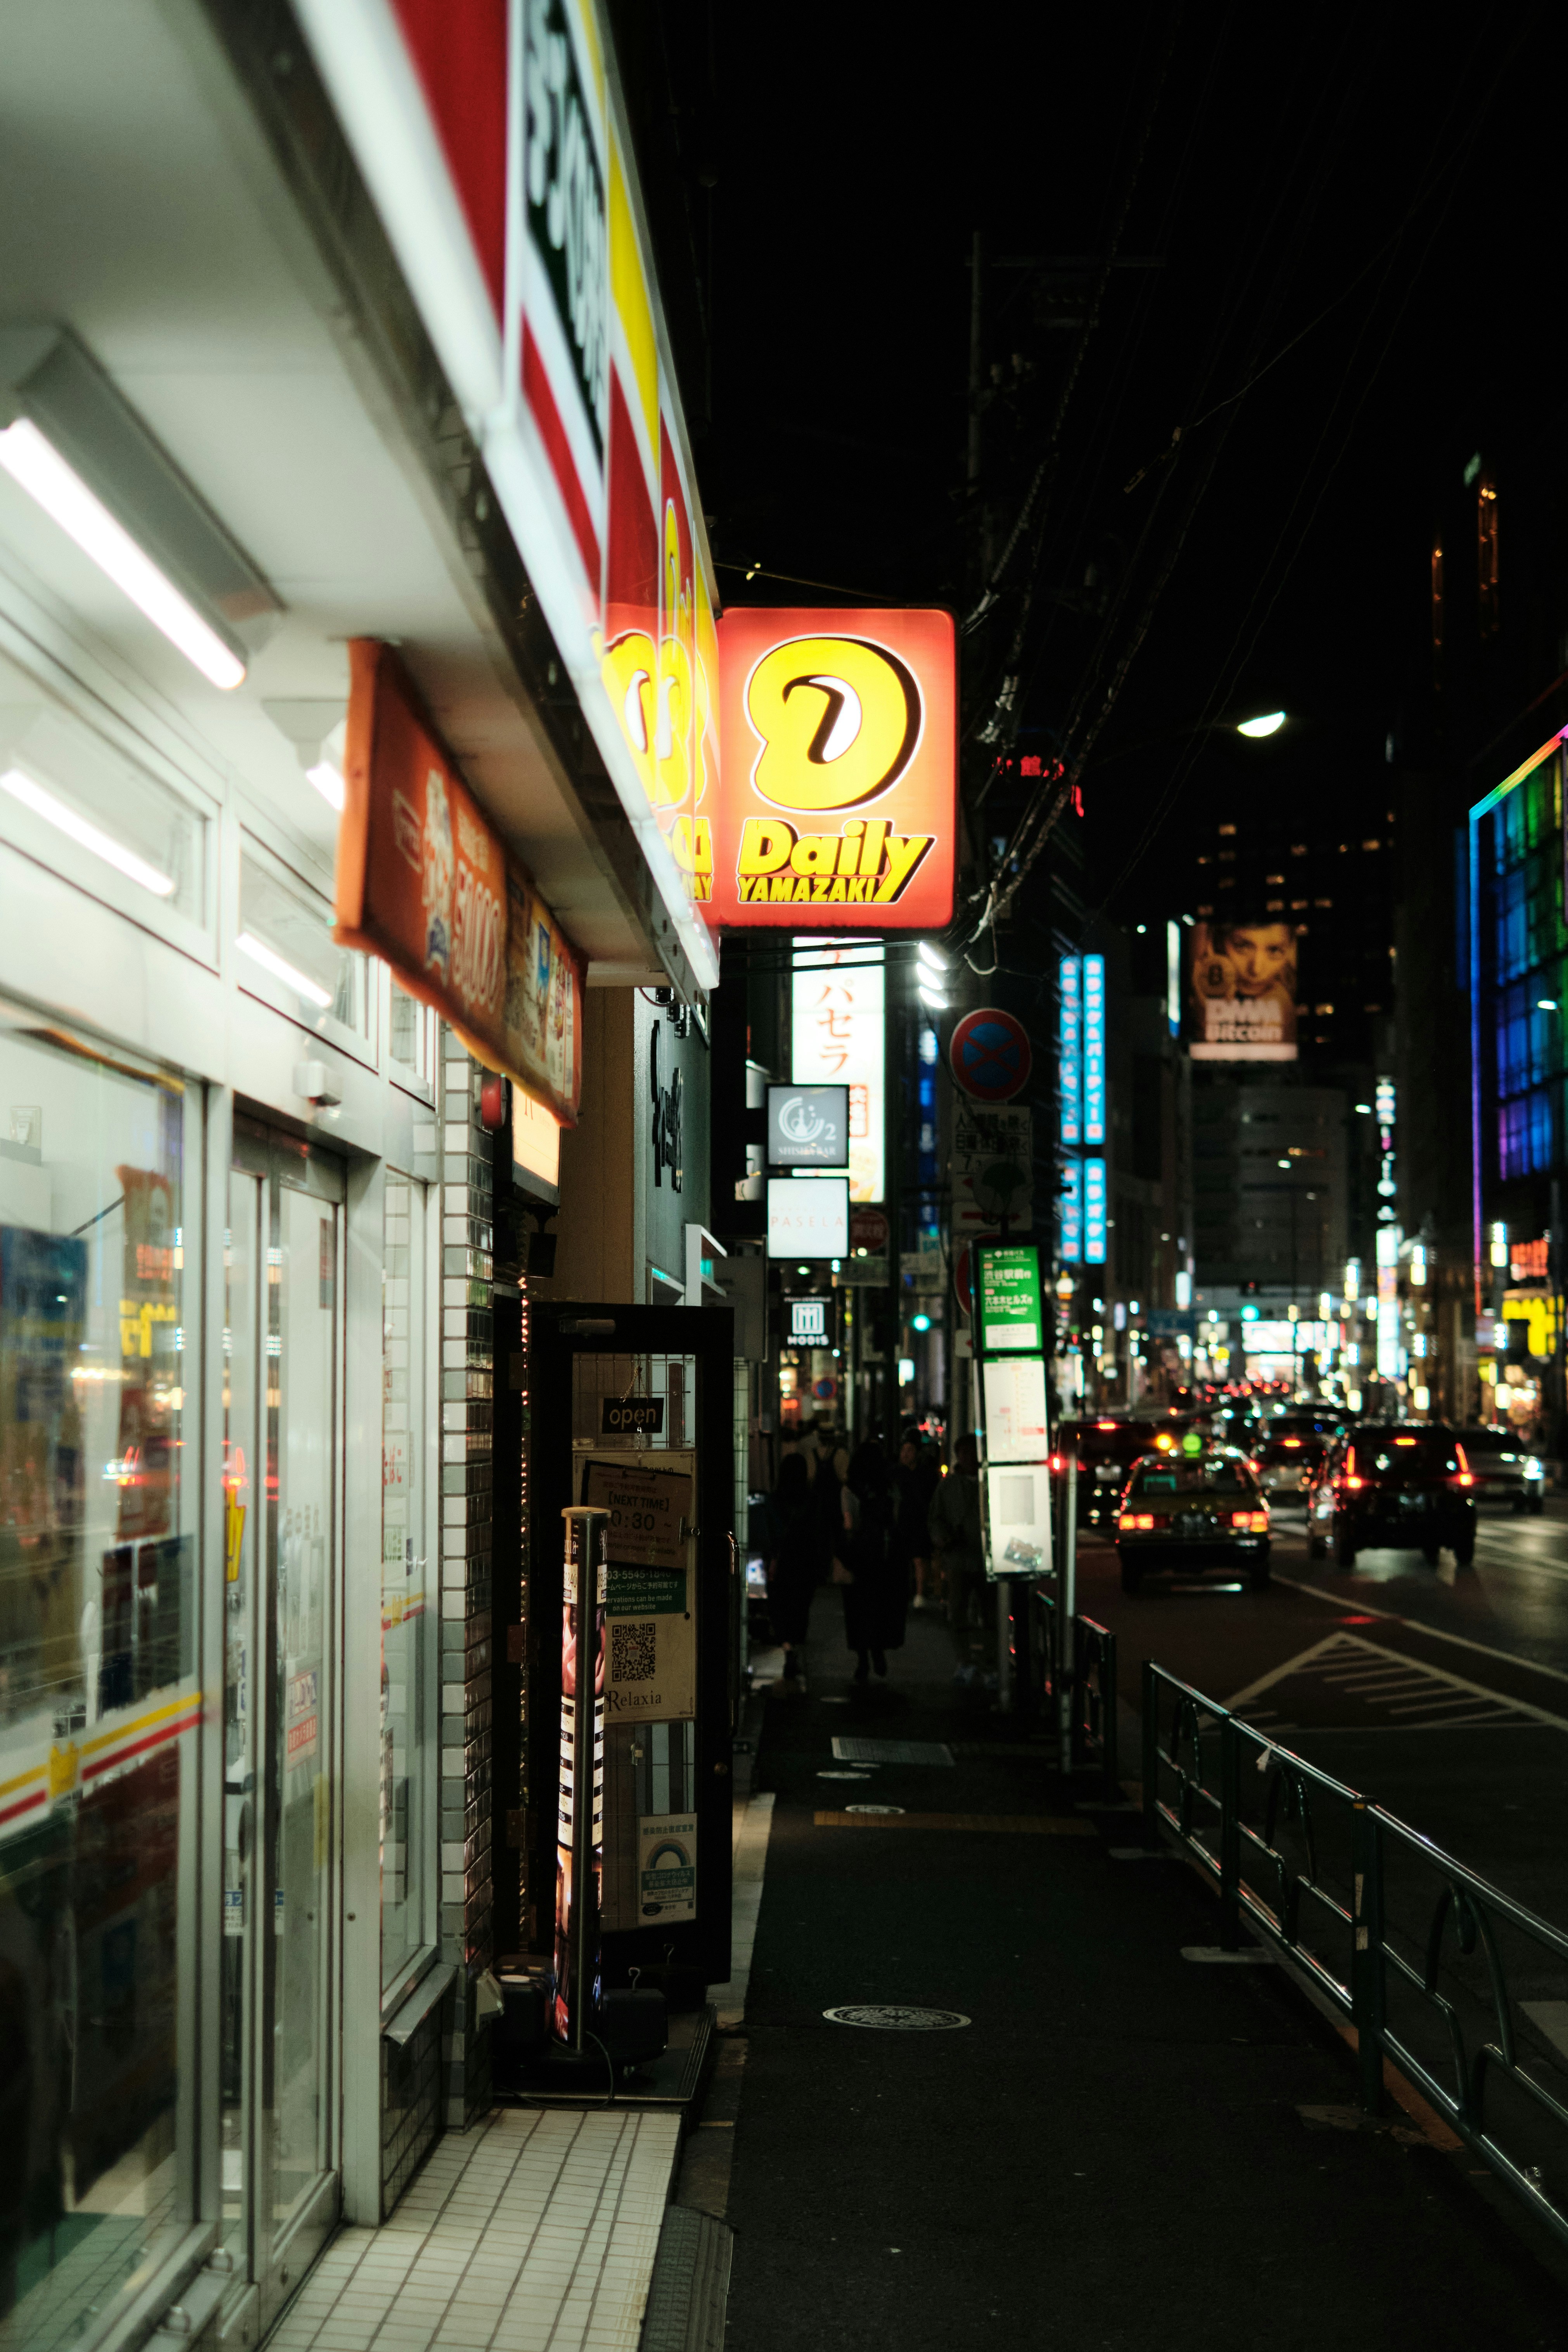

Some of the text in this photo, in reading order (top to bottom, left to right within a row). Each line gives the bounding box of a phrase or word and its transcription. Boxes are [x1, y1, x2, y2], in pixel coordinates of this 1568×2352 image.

[737, 818, 936, 903] Daily
[738, 876, 875, 903] YAMAZAKI
[771, 1216, 844, 1227] PASELA
[609, 1406, 656, 1430] open
[610, 1510, 655, 1531] 0:30
[607, 1690, 661, 1712] Relaxia
